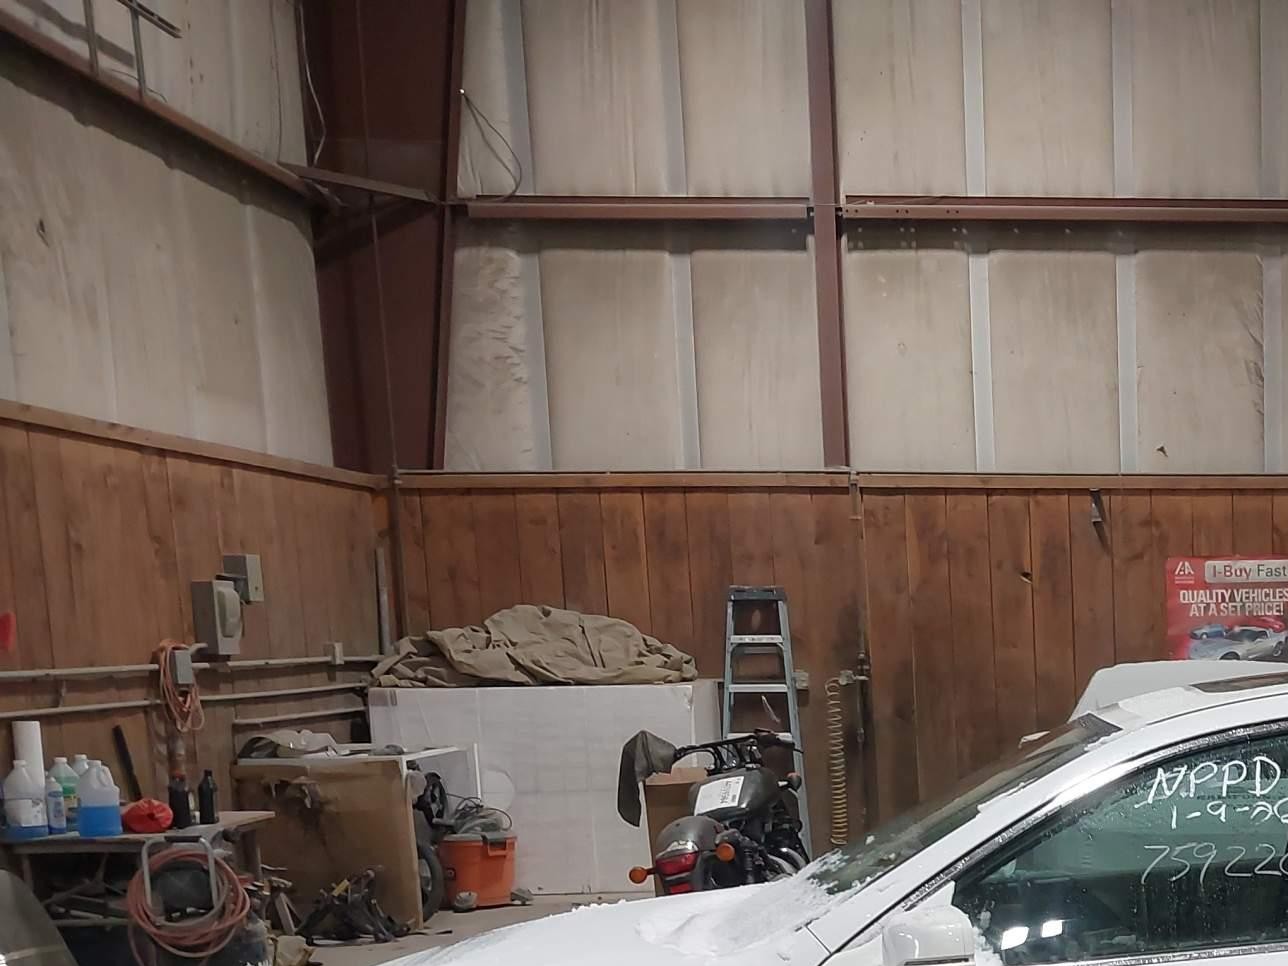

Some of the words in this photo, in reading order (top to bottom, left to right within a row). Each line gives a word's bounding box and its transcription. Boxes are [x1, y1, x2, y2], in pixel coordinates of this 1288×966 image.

[1212, 564, 1252, 580] I-Buy
[1257, 563, 1287, 578] Fast
[1179, 589, 1232, 604] QUALITY
[1189, 603, 1207, 617] AT
[1208, 603, 1218, 617] A
[1220, 603, 1243, 617] SET
[1245, 602, 1284, 616] PRICE!
